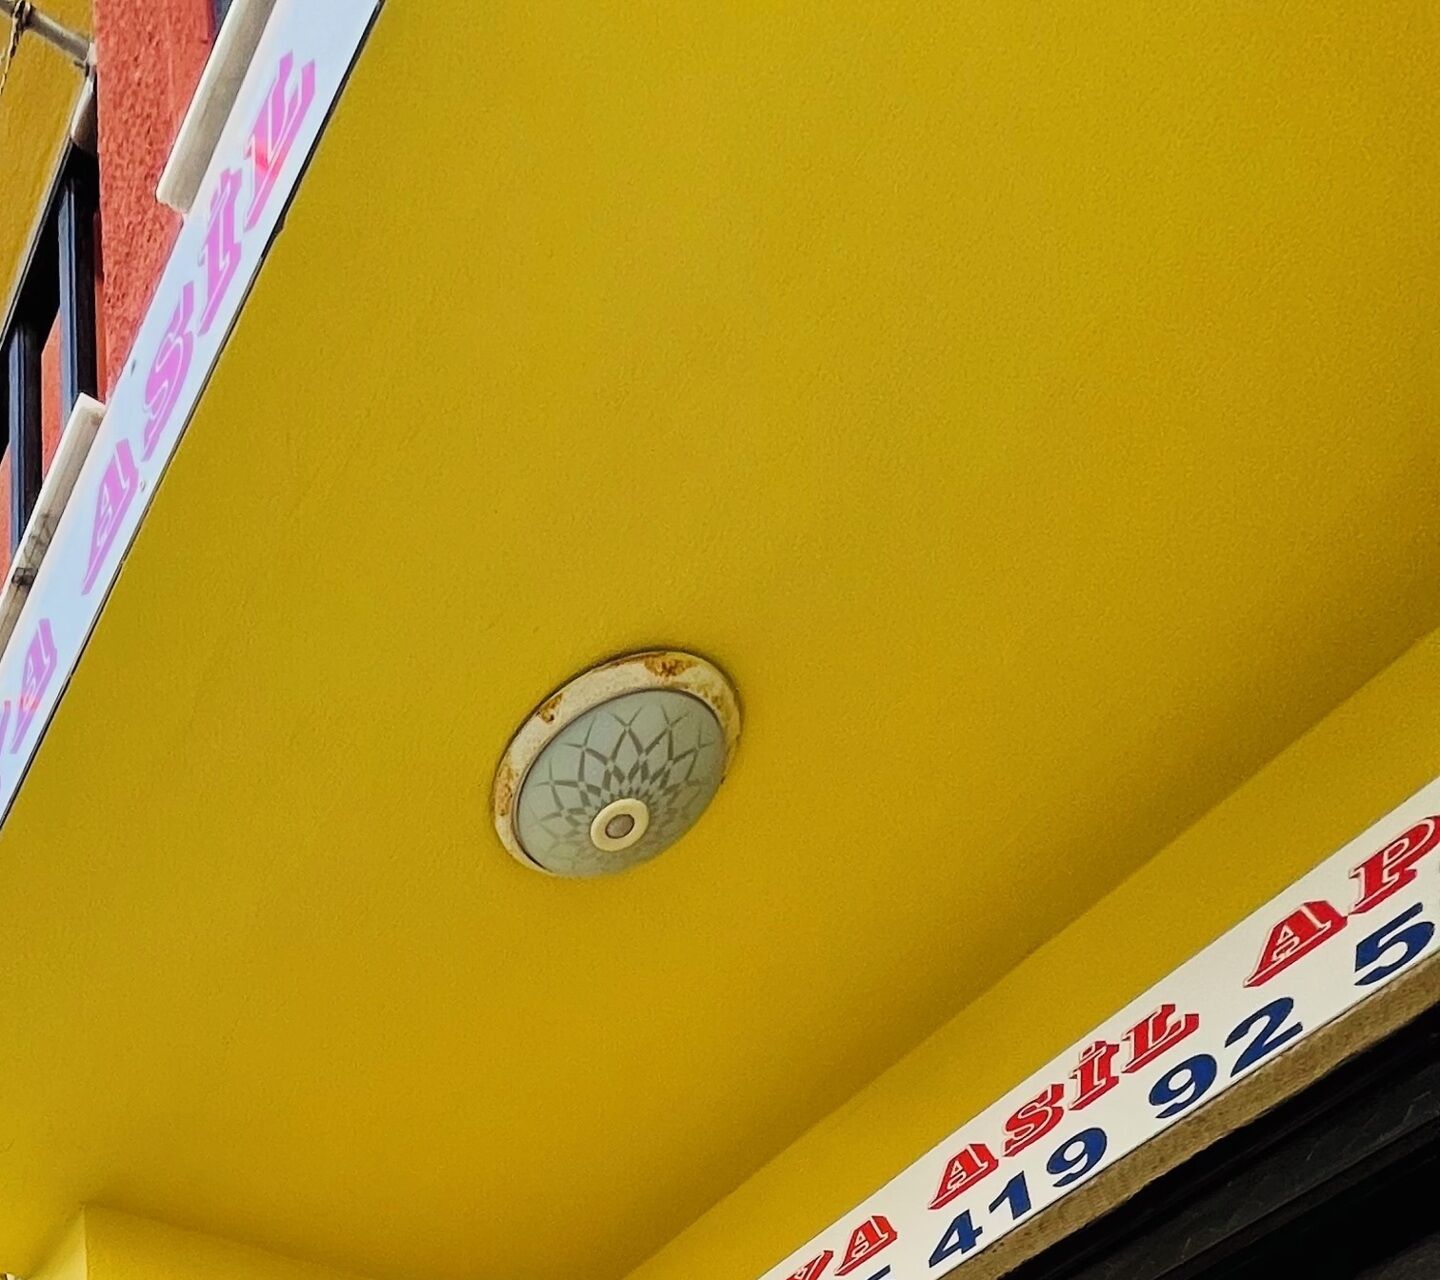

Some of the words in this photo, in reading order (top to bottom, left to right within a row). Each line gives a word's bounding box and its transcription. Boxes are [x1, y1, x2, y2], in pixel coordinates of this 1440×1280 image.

[80, 50, 317, 596] ASİL
[927, 1002, 1201, 1213] ASİL
[928, 1126, 1108, 1273] 419
[1147, 996, 1305, 1119] 92
